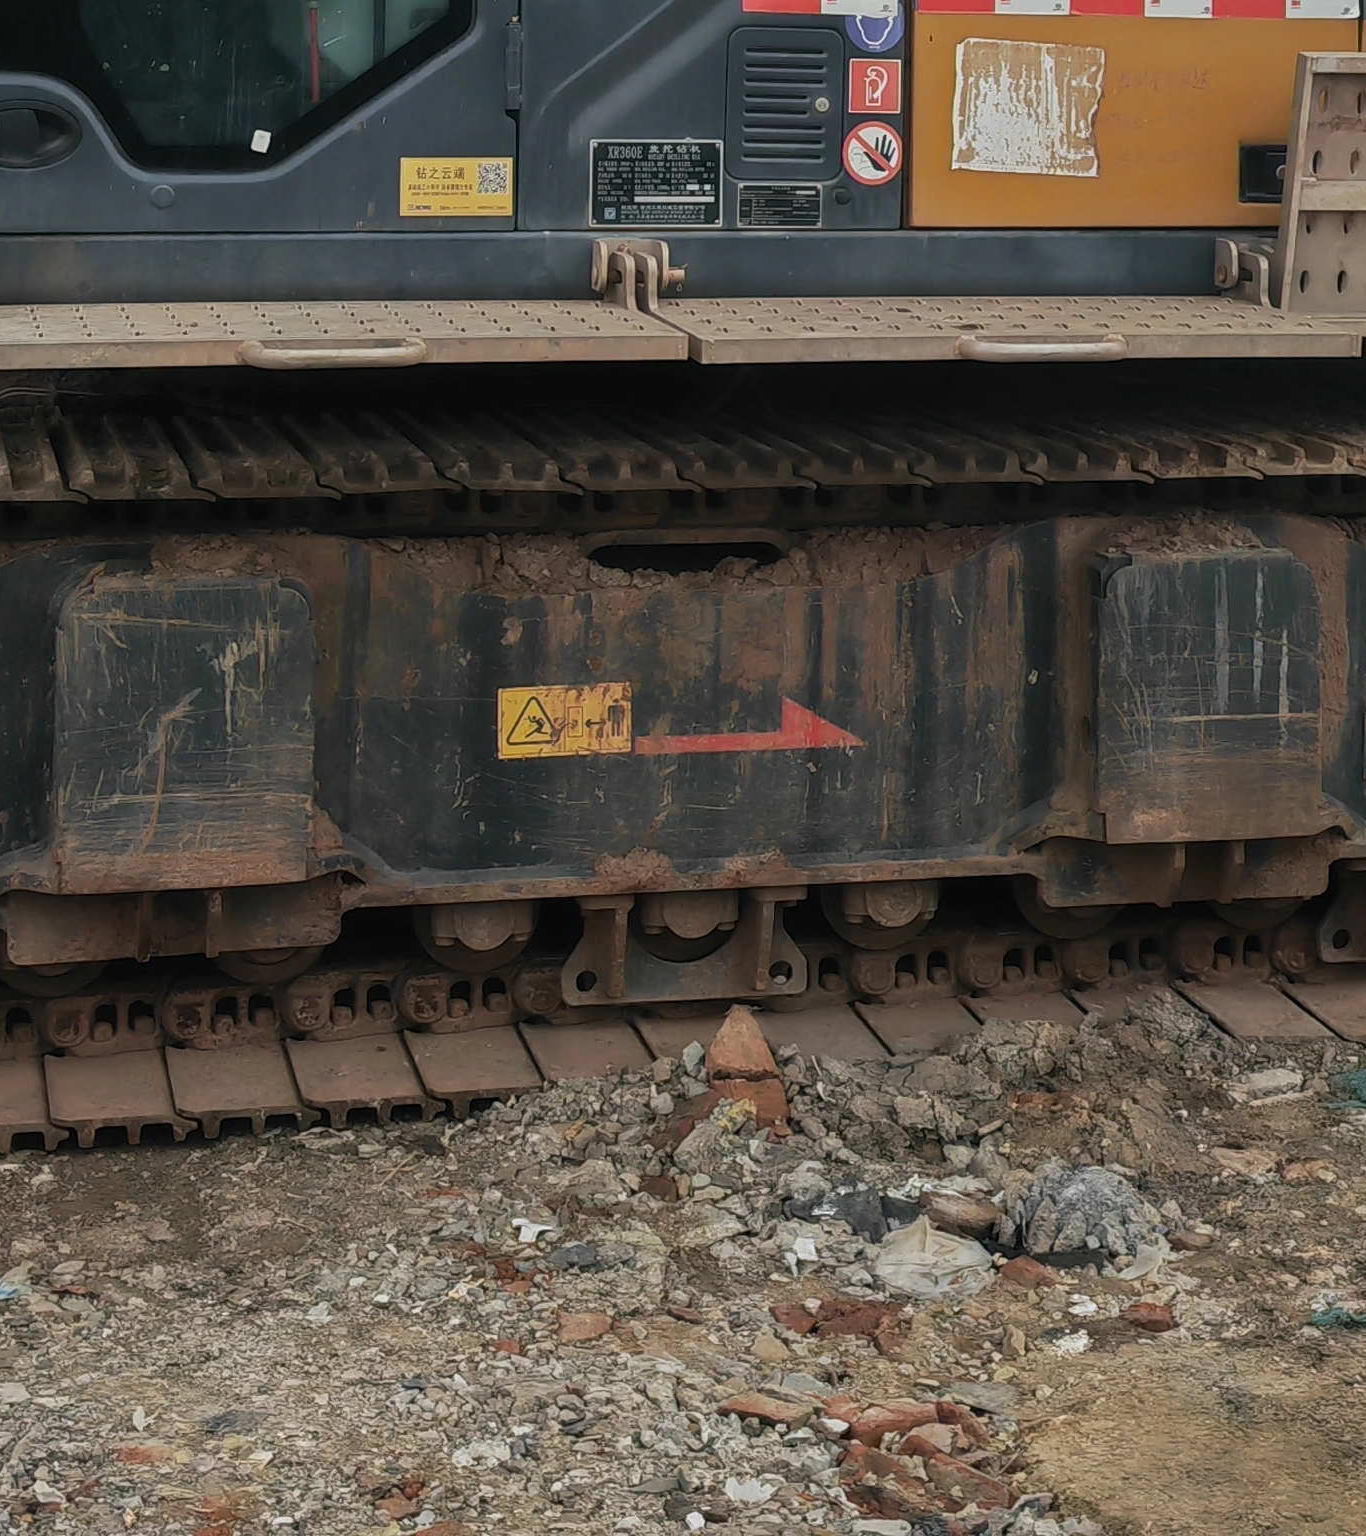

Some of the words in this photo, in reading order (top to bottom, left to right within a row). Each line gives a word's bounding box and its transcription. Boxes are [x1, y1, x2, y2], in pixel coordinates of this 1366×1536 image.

[607, 145, 644, 159] XR360E
[416, 166, 465, 180] 钻之云端
